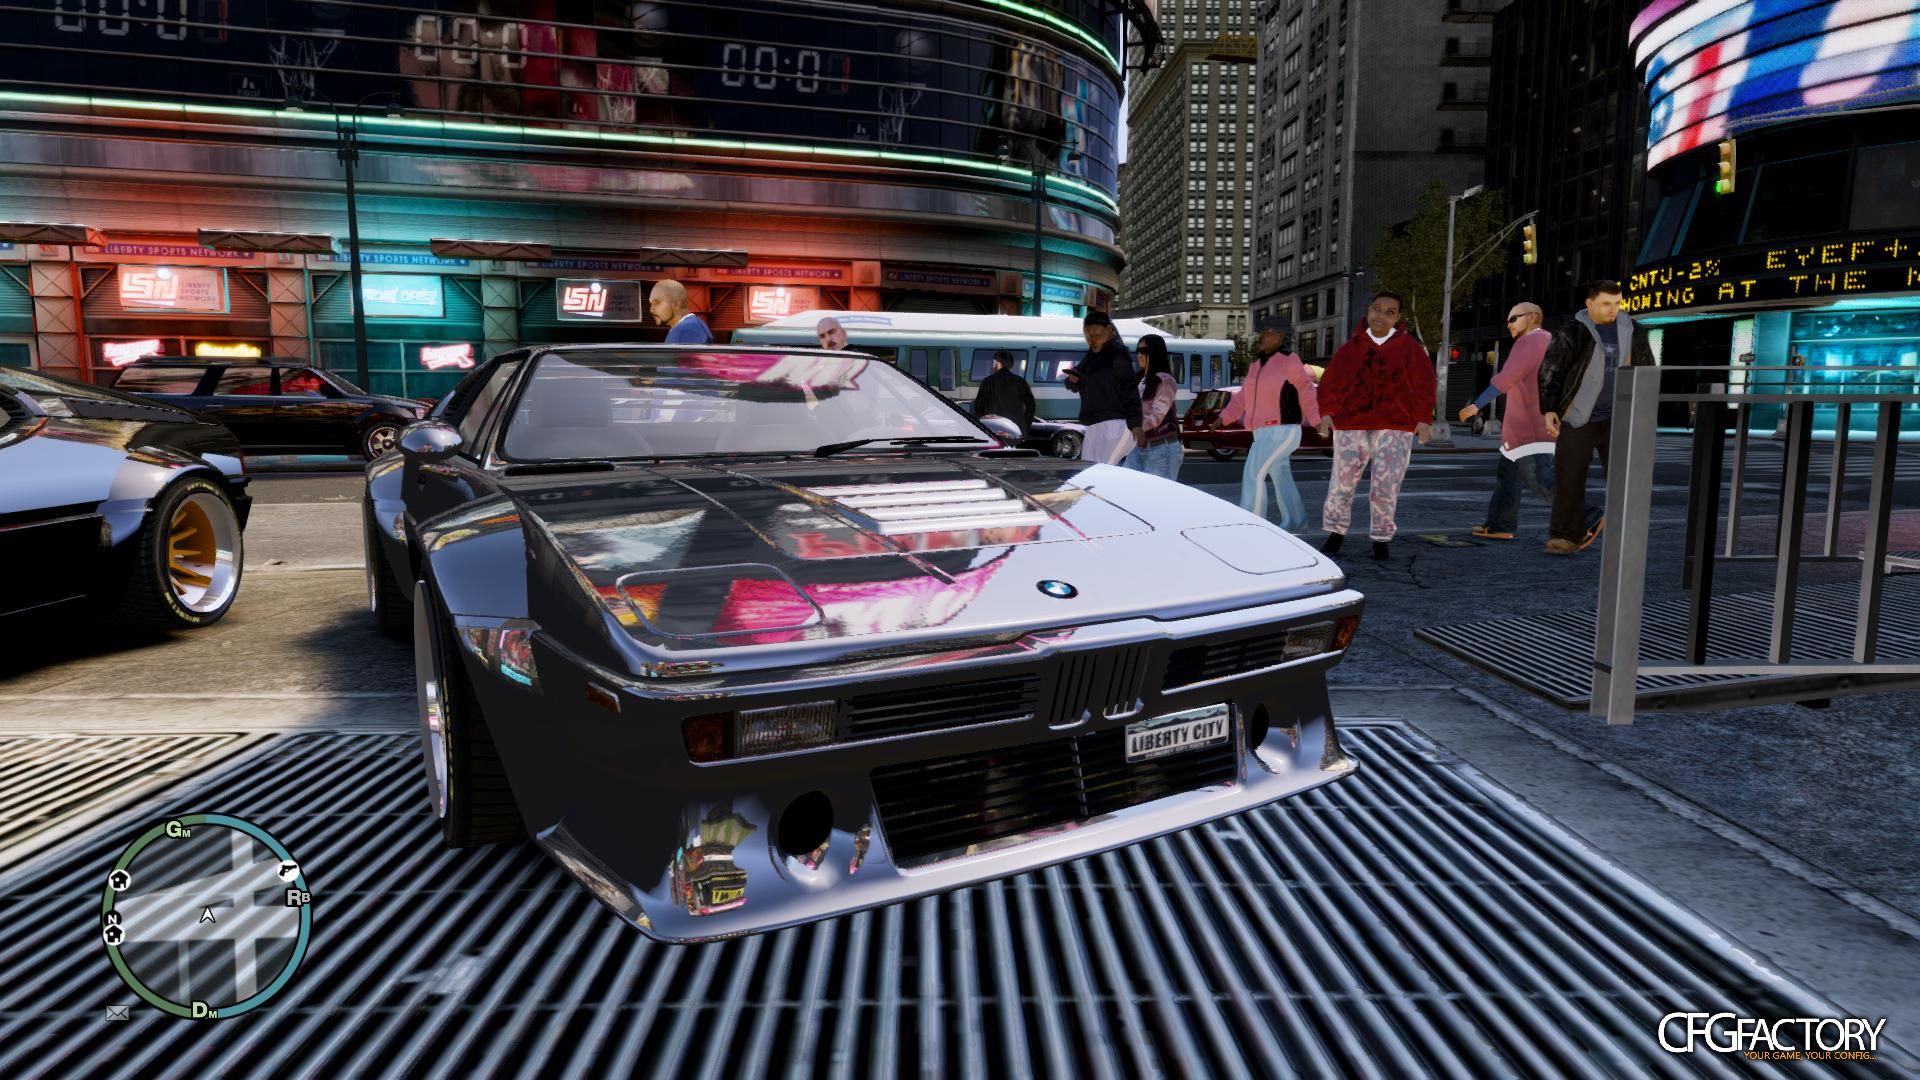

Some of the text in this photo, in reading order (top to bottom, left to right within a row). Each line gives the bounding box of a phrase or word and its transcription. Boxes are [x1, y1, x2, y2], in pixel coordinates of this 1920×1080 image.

[105, 245, 238, 258] LIBERTY SPORTS NETWORK
[335, 253, 370, 262] LIBTY
[374, 254, 408, 264] SPORTS
[1620, 270, 1867, 314] HOWING AT THE
[1131, 726, 1189, 754] LIBERTY
[1192, 719, 1224, 740] CITY
